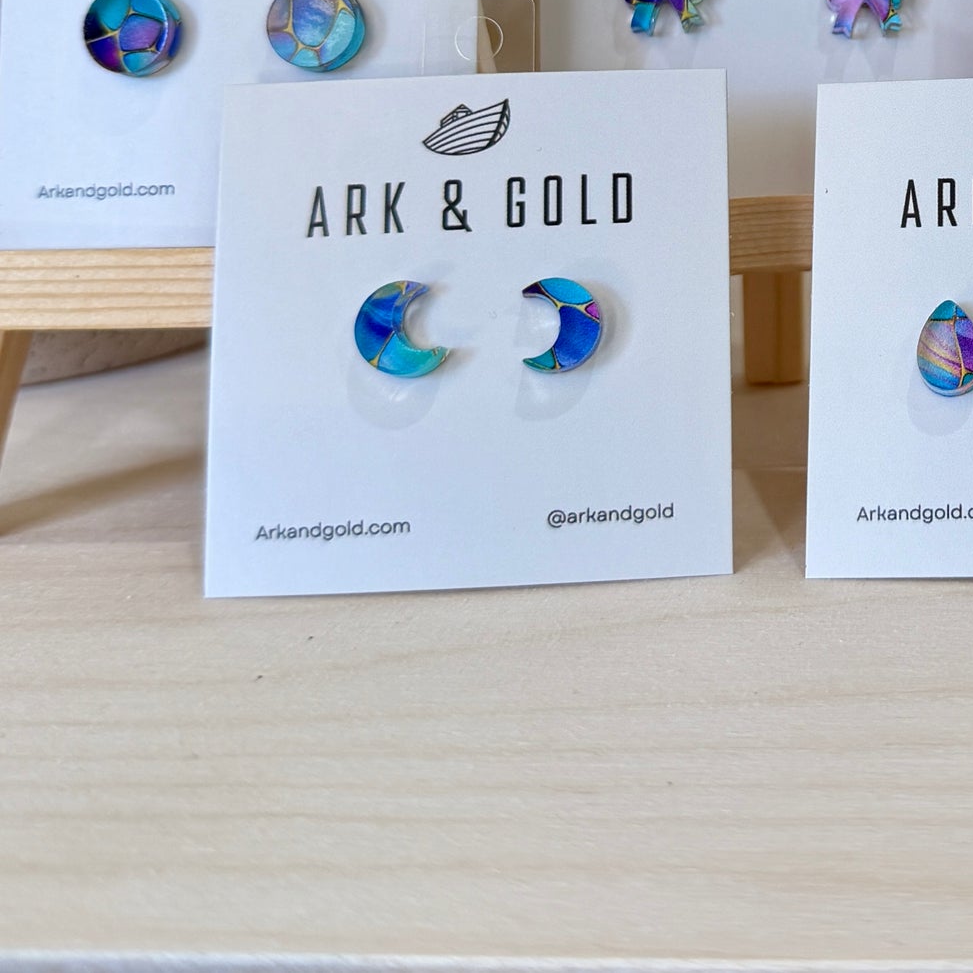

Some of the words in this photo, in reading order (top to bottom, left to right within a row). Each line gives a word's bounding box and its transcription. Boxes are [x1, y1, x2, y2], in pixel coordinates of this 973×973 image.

[37, 183, 175, 200] Arkandgold.com
[307, 182, 405, 238] ARK
[442, 180, 472, 232] &
[507, 173, 632, 228] GOLD
[547, 503, 674, 528] @arkandgold
[256, 520, 410, 541] Arkandgold.com
